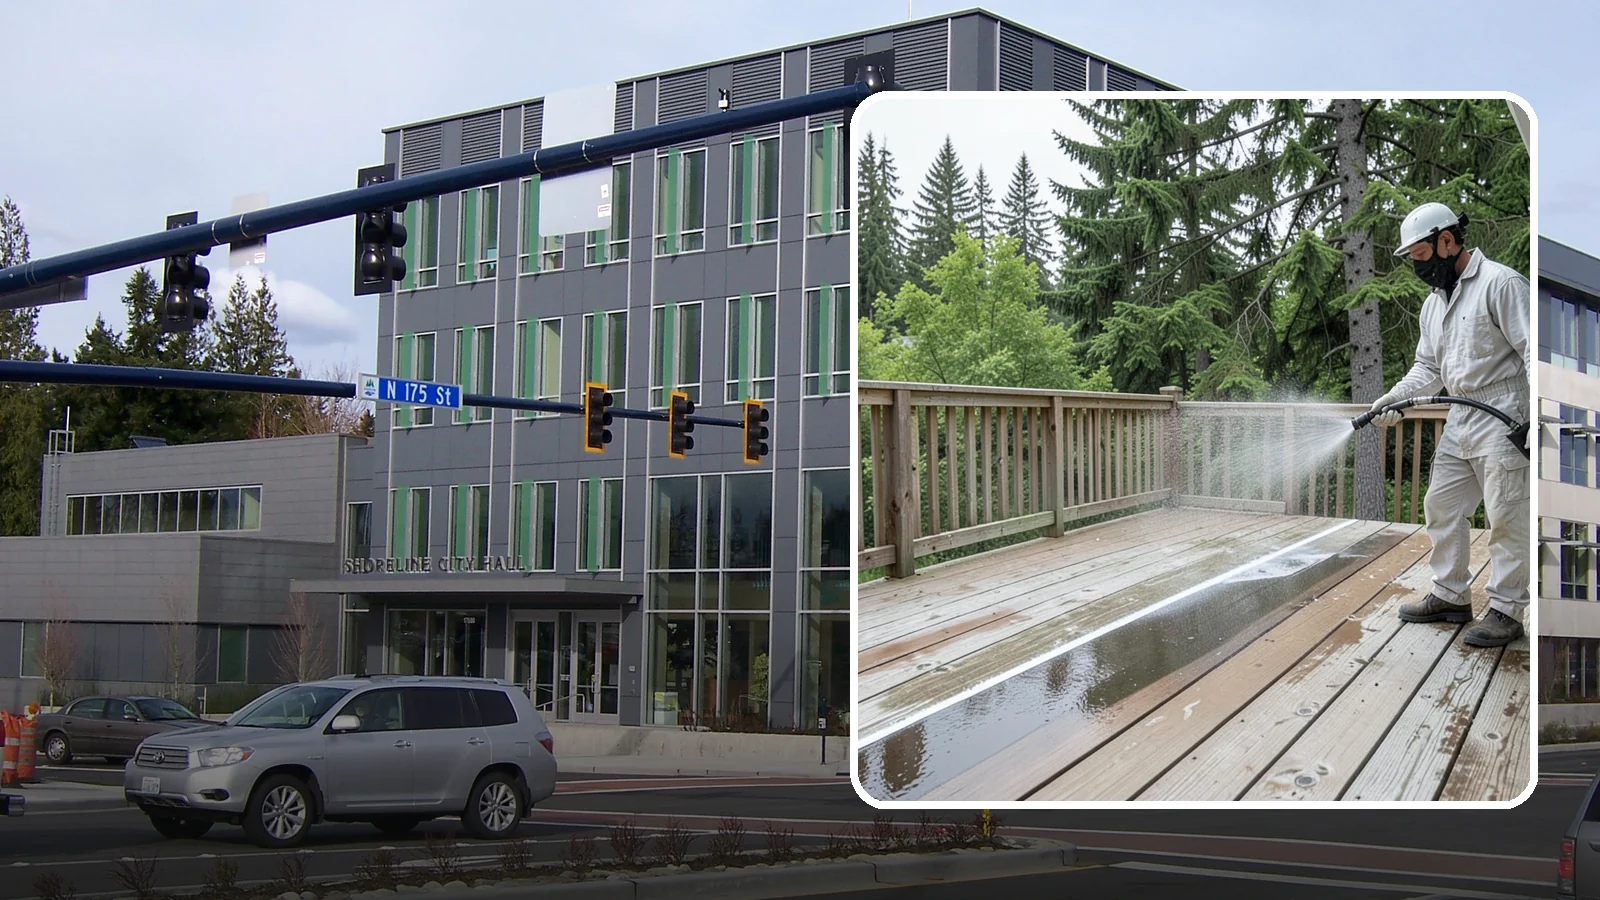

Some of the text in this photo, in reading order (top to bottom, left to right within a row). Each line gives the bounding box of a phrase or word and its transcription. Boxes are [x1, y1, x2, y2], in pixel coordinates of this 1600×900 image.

[387, 381, 452, 406] N 175 St
[344, 556, 525, 574] SHORELINE CITY HALL
